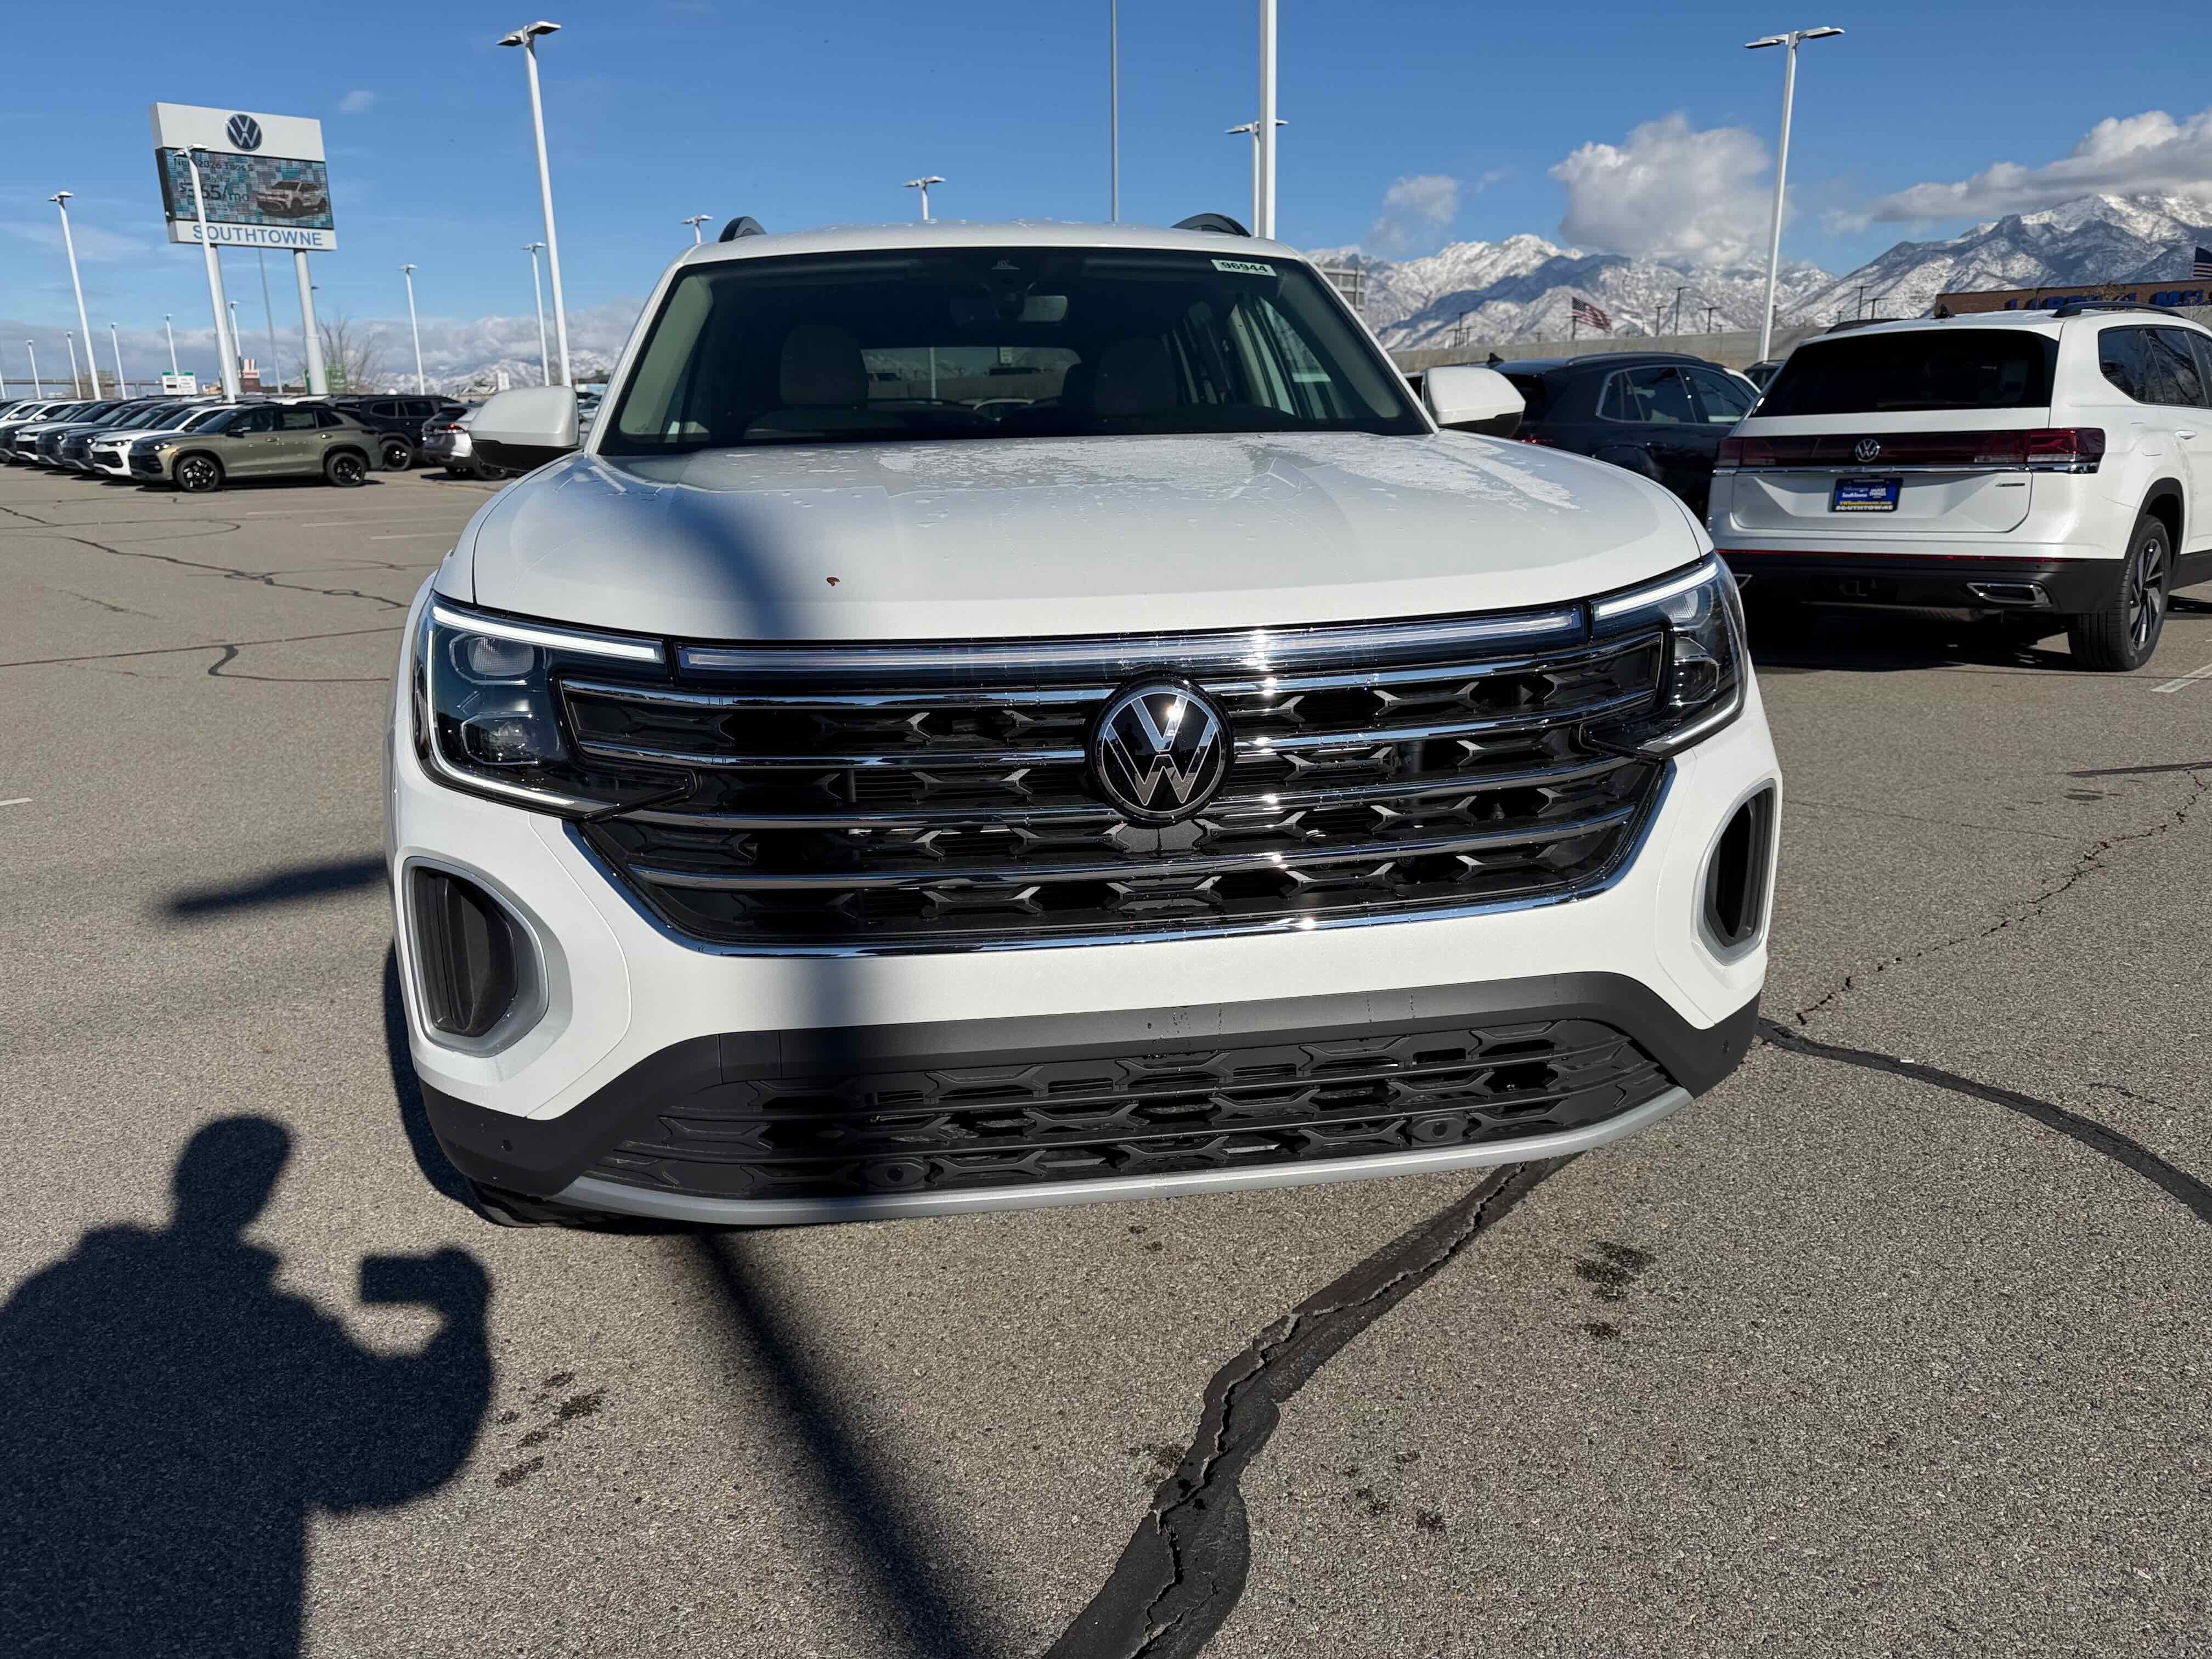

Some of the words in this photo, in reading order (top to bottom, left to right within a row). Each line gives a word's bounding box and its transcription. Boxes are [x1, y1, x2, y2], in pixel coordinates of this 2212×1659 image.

[227, 114, 263, 152] VW
[193, 224, 323, 246] SOUTHTOWNE
[1221, 262, 1268, 273] 96944
[1855, 439, 1880, 461] VW
[1099, 687, 1225, 816] VW
